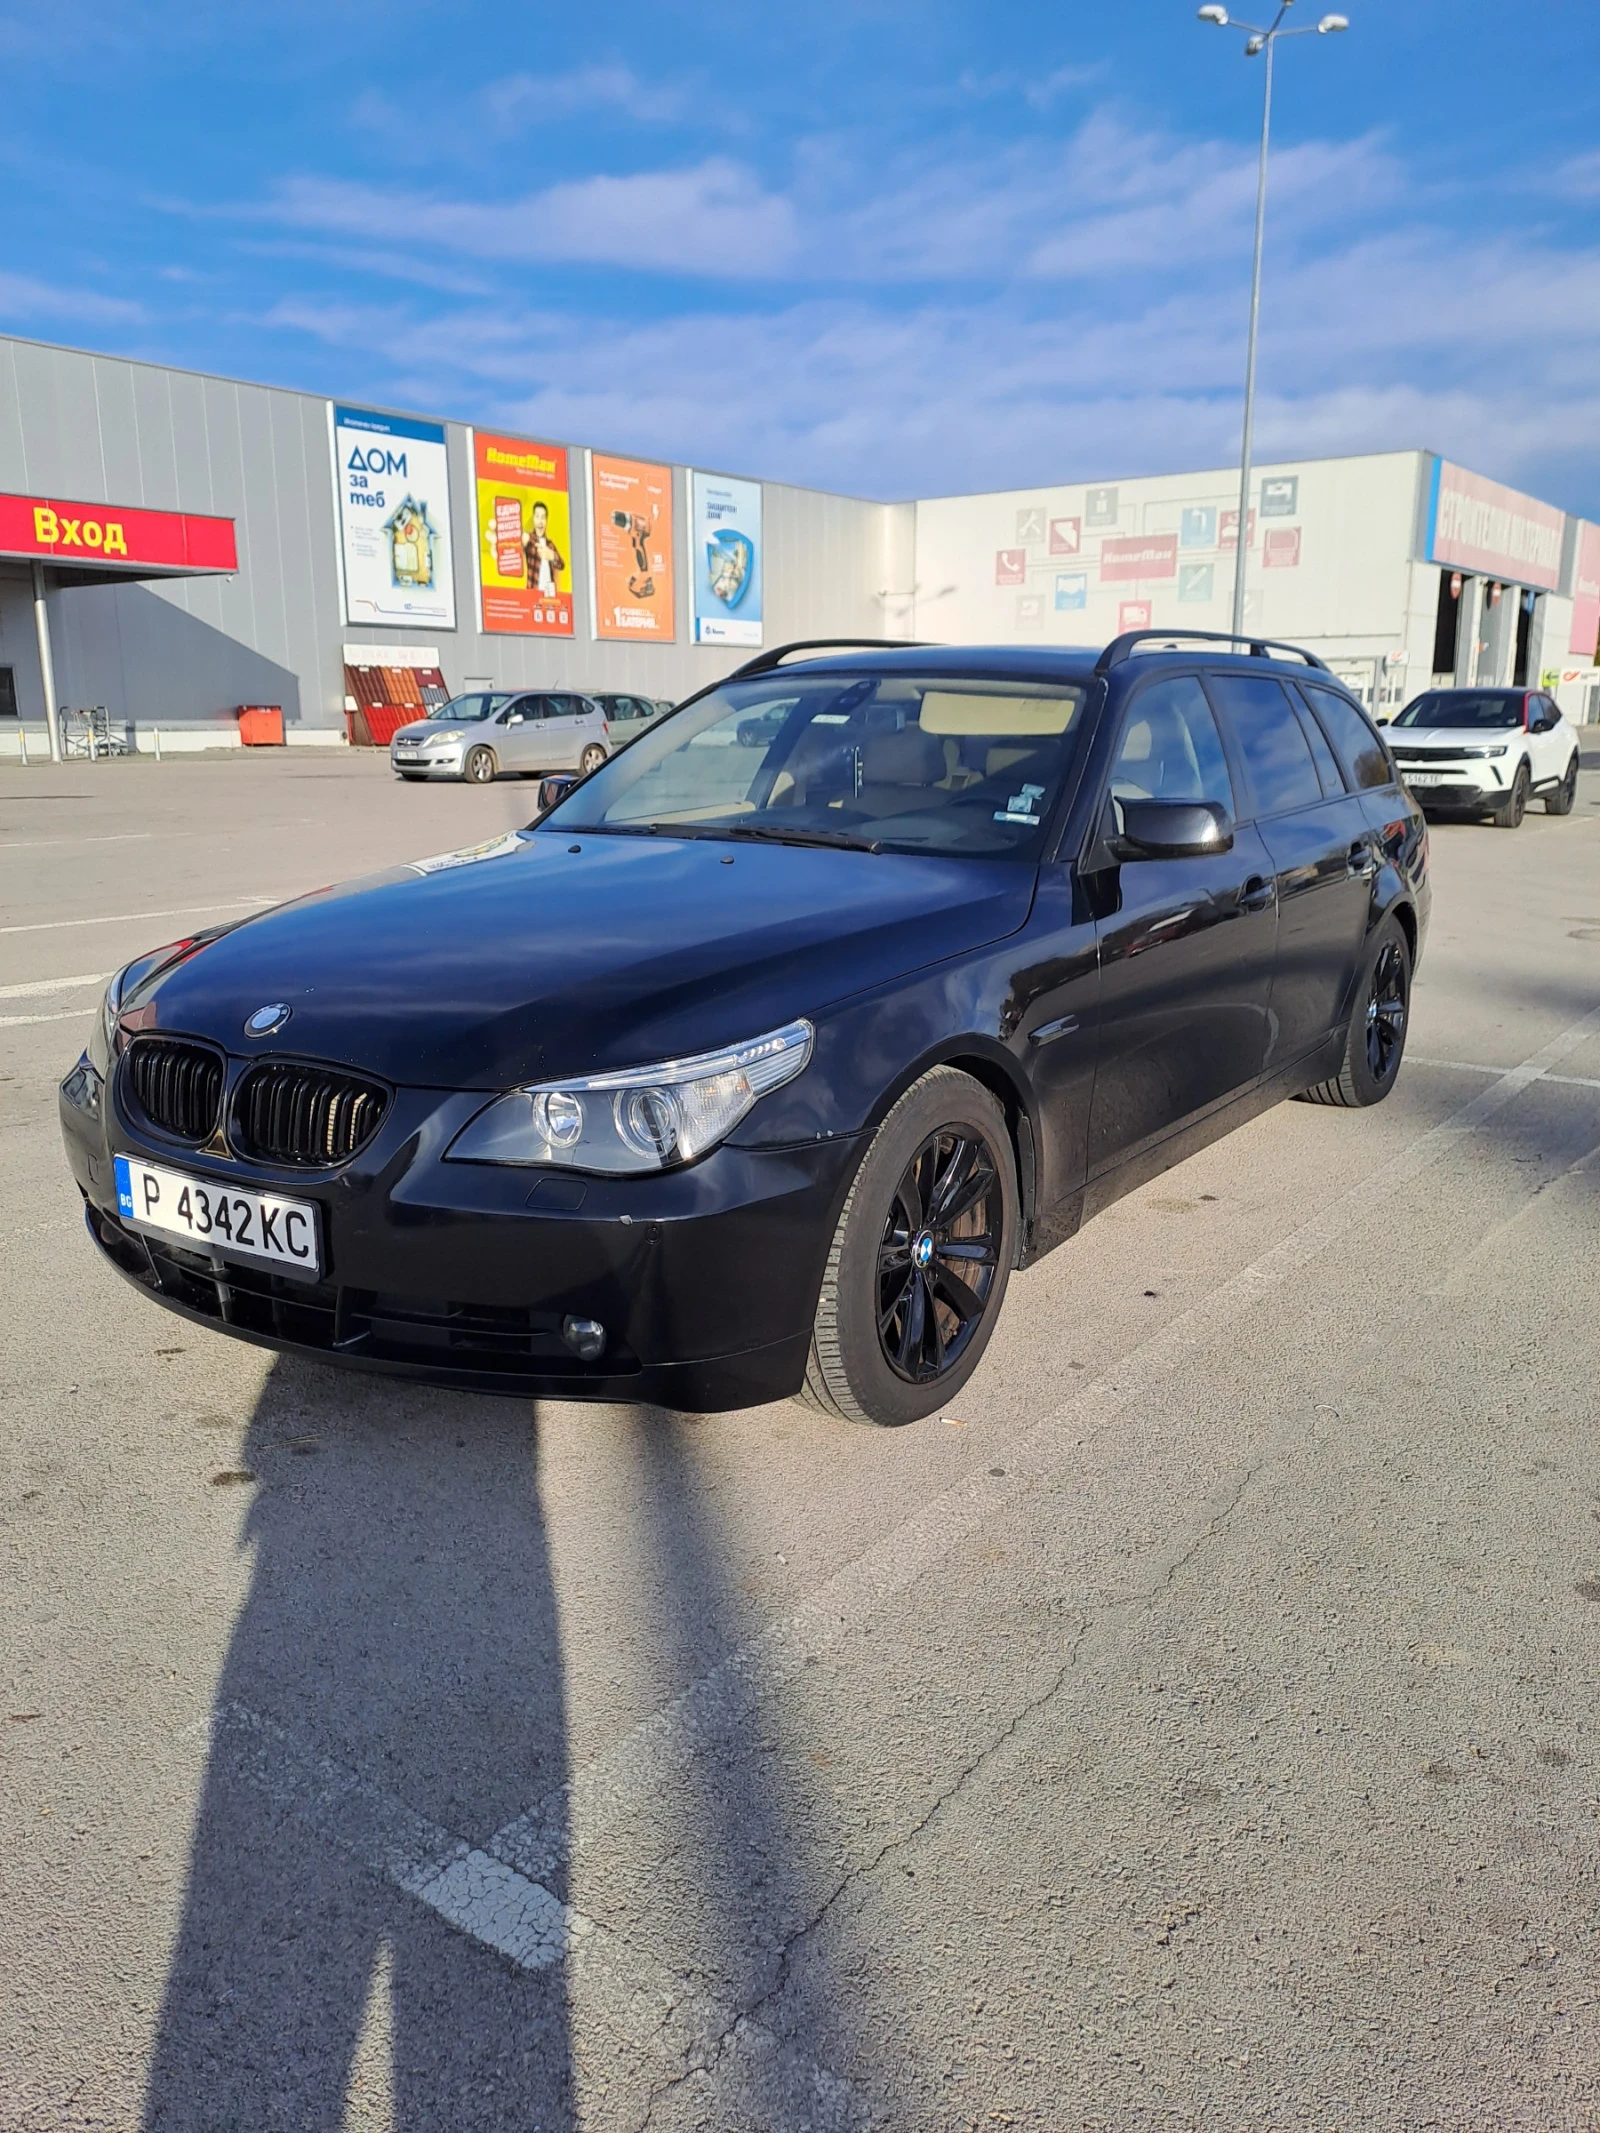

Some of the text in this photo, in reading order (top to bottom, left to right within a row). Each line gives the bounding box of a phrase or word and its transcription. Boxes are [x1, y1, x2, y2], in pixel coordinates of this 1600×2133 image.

[348, 445, 408, 478] ДОМ
[486, 447, 556, 474] HomeMax
[350, 473, 368, 489] за
[350, 491, 386, 509] теб
[33, 507, 128, 555] Вход
[120, 1193, 132, 1208] BG
[143, 1173, 160, 1216] P
